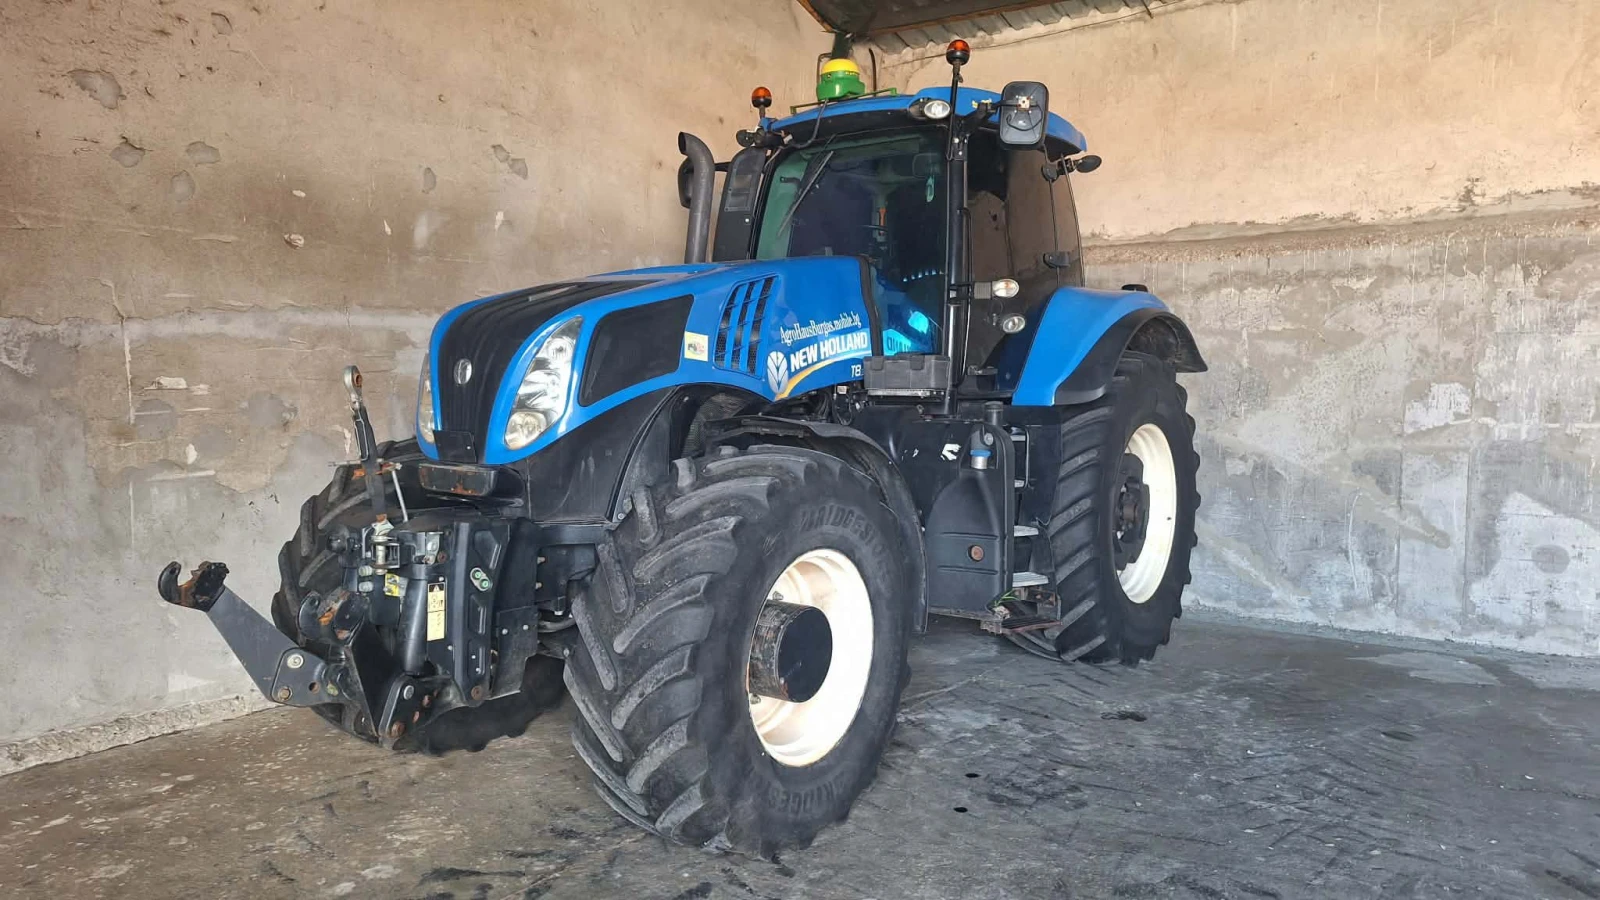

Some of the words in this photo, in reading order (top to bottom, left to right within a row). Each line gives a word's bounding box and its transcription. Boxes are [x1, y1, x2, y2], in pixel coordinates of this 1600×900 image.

[781, 311, 861, 346] AgroHausBurgas.mobile.bg
[790, 343, 819, 372] NEW
[820, 332, 868, 358] HOLLAND
